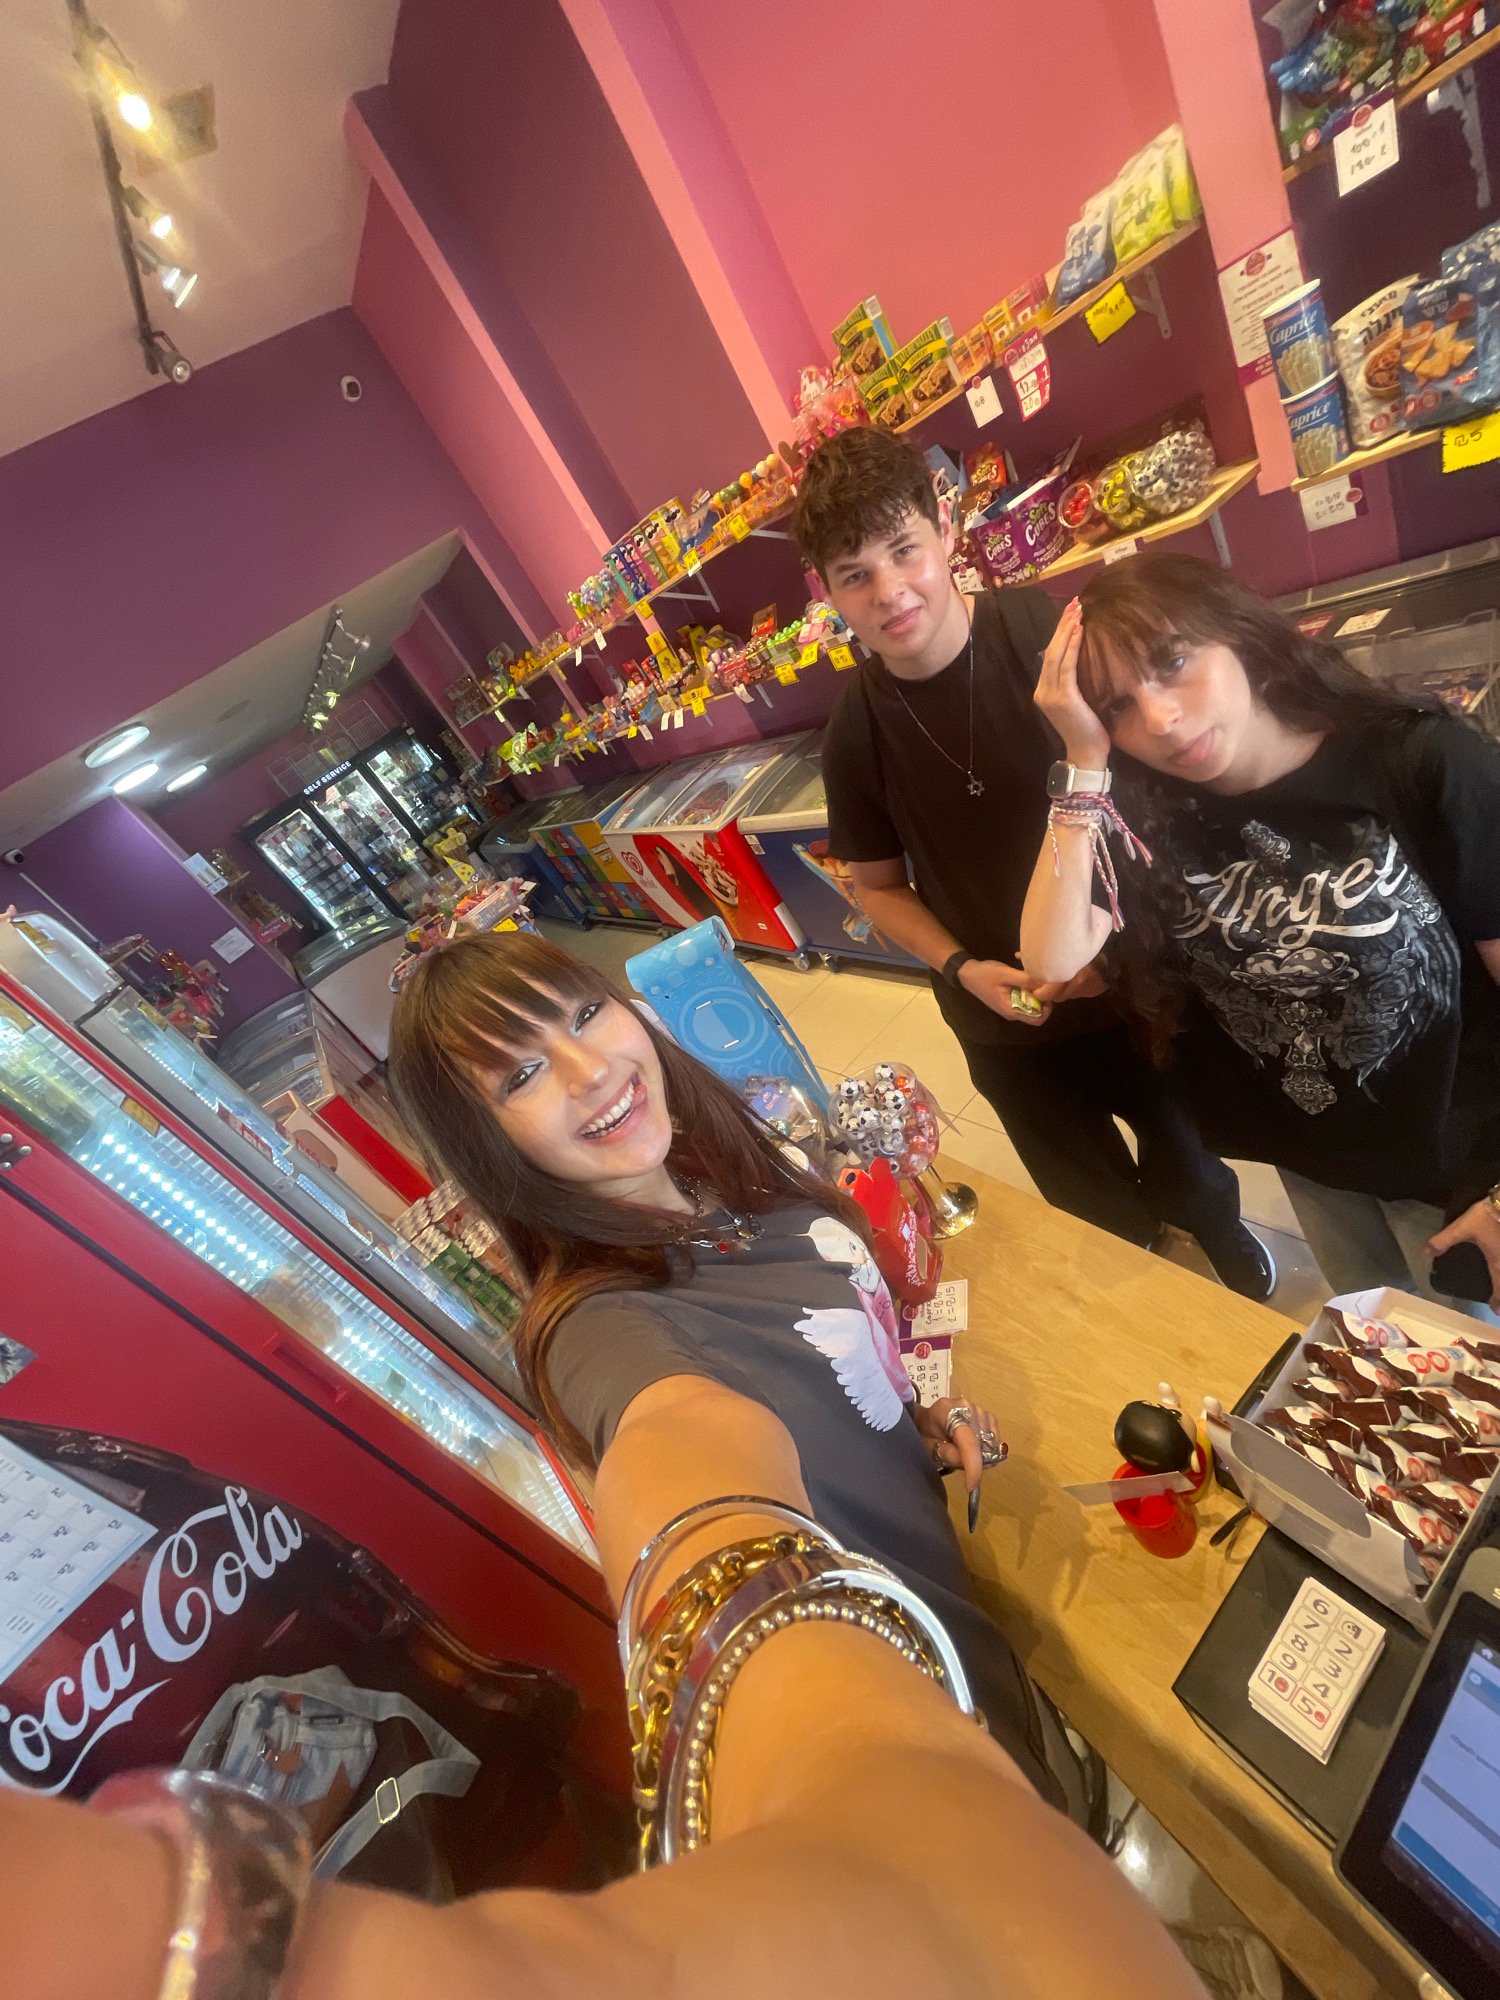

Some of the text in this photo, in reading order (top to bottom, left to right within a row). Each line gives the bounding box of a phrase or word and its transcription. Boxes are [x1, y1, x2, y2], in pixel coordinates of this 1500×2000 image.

[1270, 311, 1316, 344] Caprice
[1029, 502, 1049, 524] Soft
[1025, 501, 1056, 546] CUBES
[985, 533, 1012, 560] CUBES
[303, 760, 351, 795] SELF SERVICE
[1174, 832, 1408, 951] Angel
[1312, 1599, 1330, 1615] 6
[1304, 1615, 1320, 1629] 7
[0, 1485, 304, 1795] oca-Cola
[1291, 1634, 1308, 1652] 8
[1335, 1640, 1352, 1660] 2
[1281, 1653, 1297, 1670] 9
[1324, 1659, 1342, 1678] 3
[1312, 1684, 1328, 1698] 4
[1297, 1697, 1316, 1714] 5
